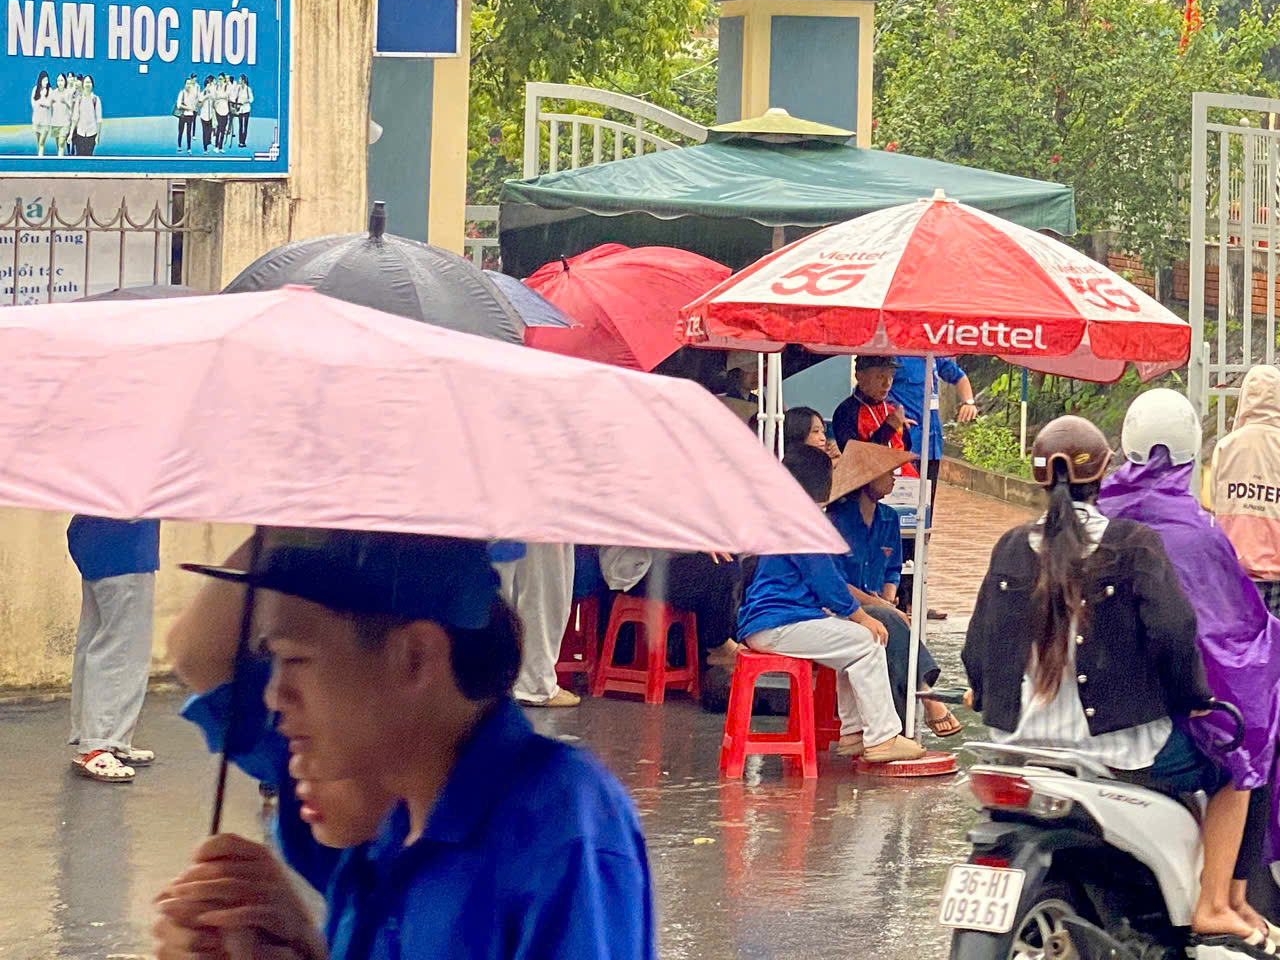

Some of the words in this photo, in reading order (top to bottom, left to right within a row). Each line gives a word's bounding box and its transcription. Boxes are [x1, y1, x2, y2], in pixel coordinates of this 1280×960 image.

[107, 4, 180, 74] HỌC
[771, 262, 878, 297] 5G
[923, 319, 1047, 350] viettel
[956, 870, 1011, 899] 36-H1
[944, 897, 1009, 927] 093.61
